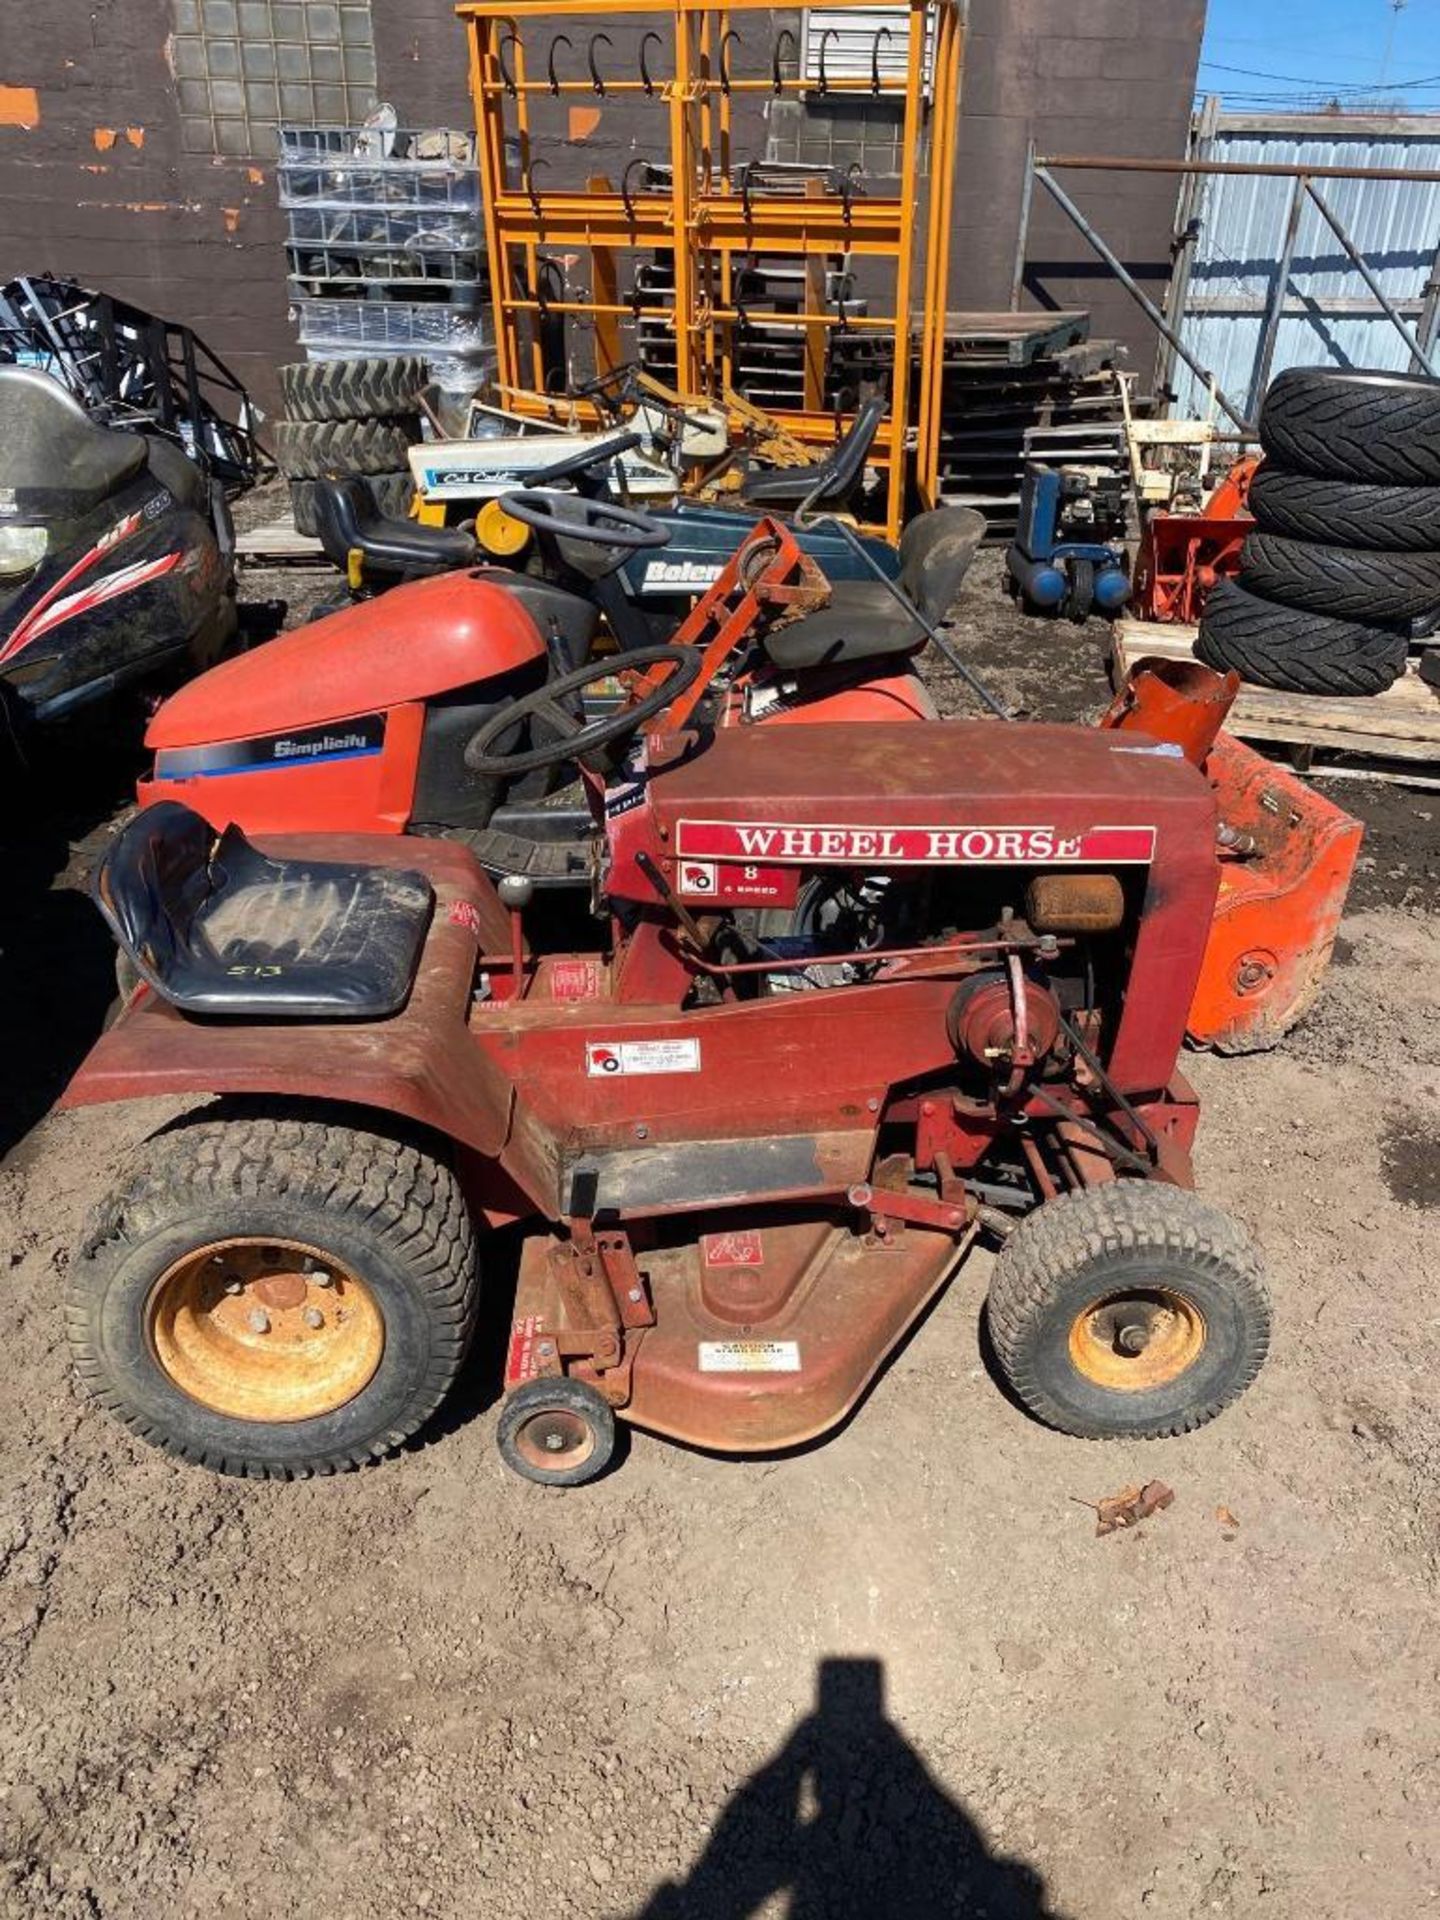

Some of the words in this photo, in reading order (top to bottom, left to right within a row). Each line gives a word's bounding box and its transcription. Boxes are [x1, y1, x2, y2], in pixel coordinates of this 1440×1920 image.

[645, 562, 725, 581] Bolen
[274, 734, 366, 757] Simplicity
[736, 829, 904, 857] WHEEL
[926, 831, 1082, 858] HORSE
[744, 864, 758, 880] 8
[737, 885, 778, 895] SPEED
